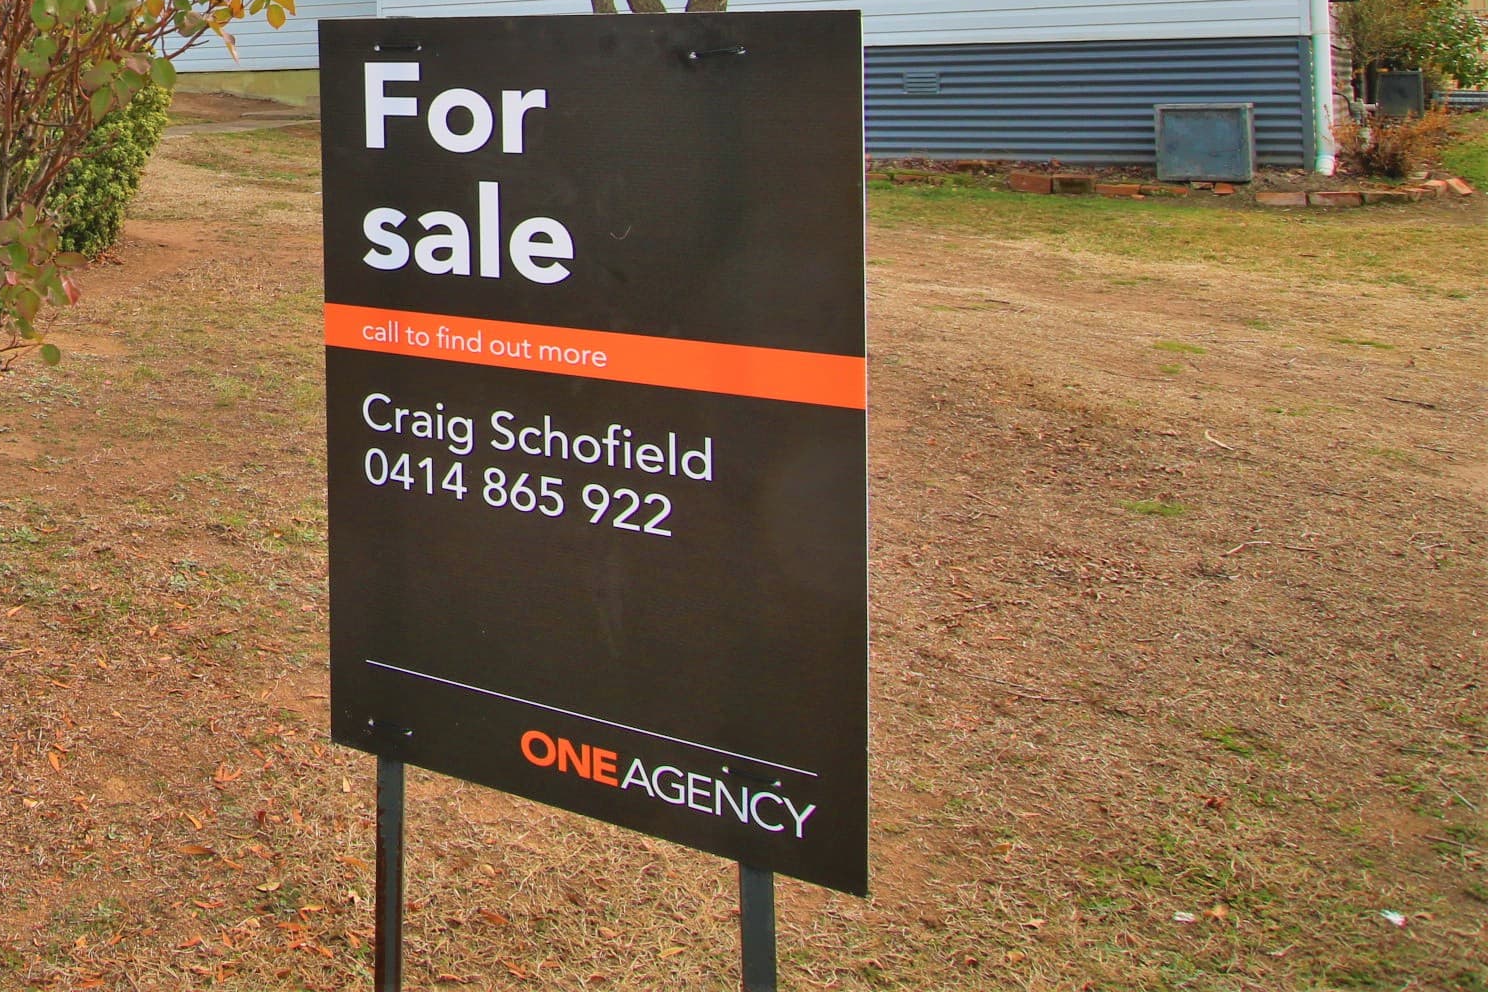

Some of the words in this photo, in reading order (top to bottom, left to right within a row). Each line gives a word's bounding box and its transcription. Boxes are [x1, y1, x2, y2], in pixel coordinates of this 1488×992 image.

[363, 62, 547, 154] For
[362, 181, 574, 284] sale
[362, 320, 399, 343] call
[404, 326, 431, 347] to
[436, 325, 483, 353] find
[489, 339, 532, 360] out
[539, 345, 608, 368] more
[362, 392, 474, 456] Craig
[490, 410, 714, 482] Schofield
[364, 447, 468, 500] 0414
[482, 467, 564, 517] 865
[581, 483, 672, 537] 922
